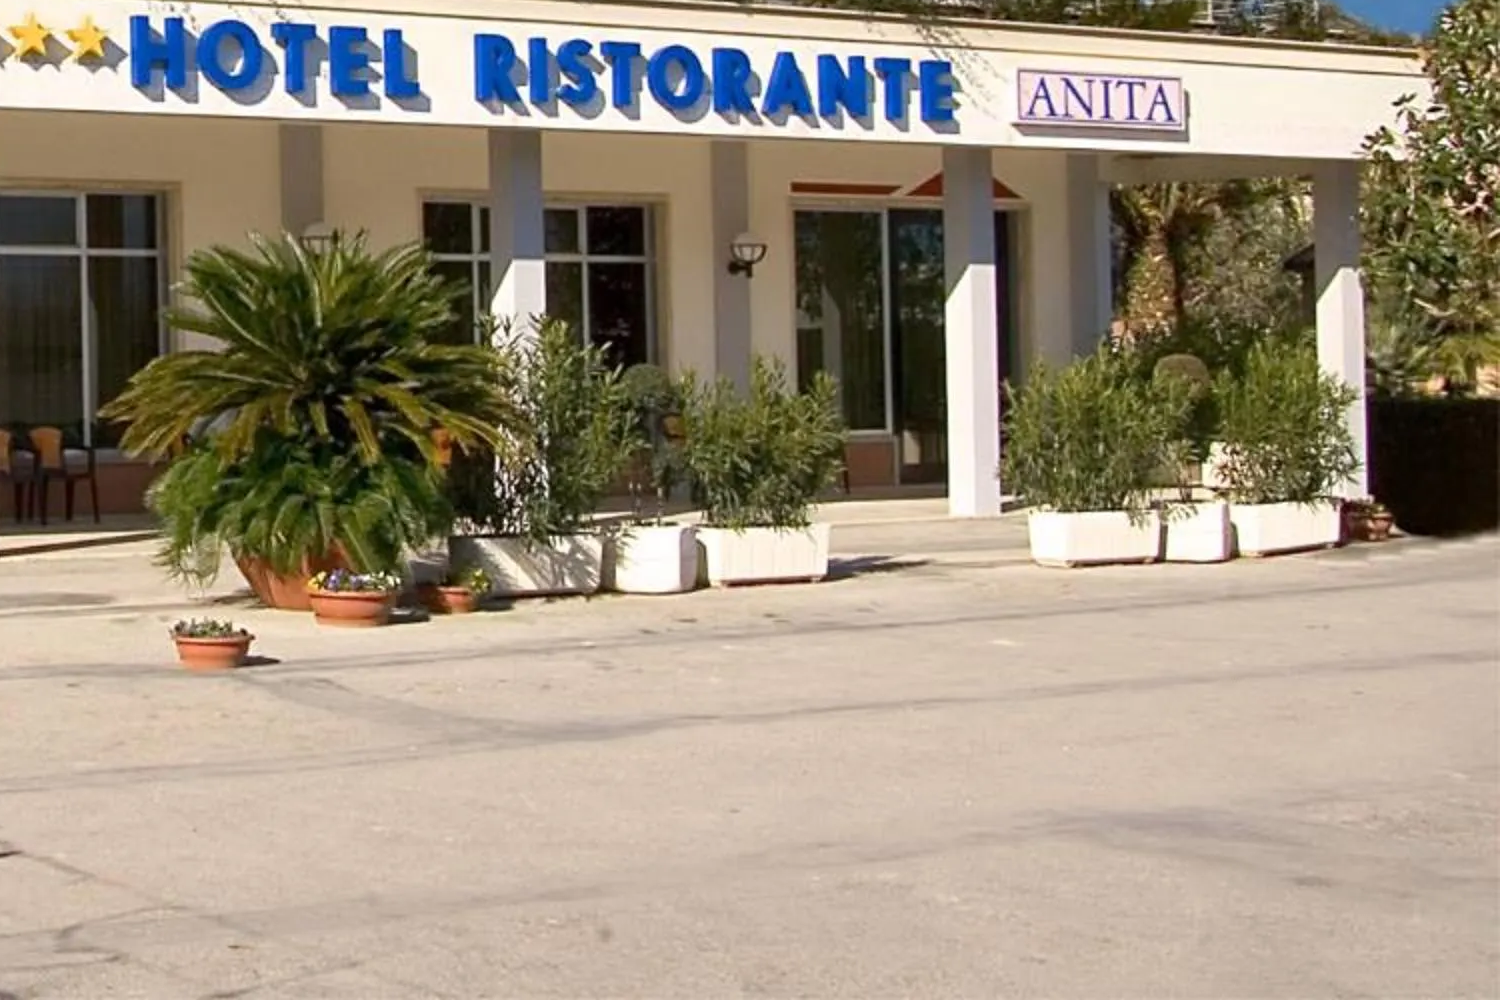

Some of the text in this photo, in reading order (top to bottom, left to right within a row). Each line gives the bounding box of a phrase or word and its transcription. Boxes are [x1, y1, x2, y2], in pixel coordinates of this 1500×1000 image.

[129, 15, 956, 121] HOTEL RISTORANTE
[1026, 76, 1176, 122] ANITA
